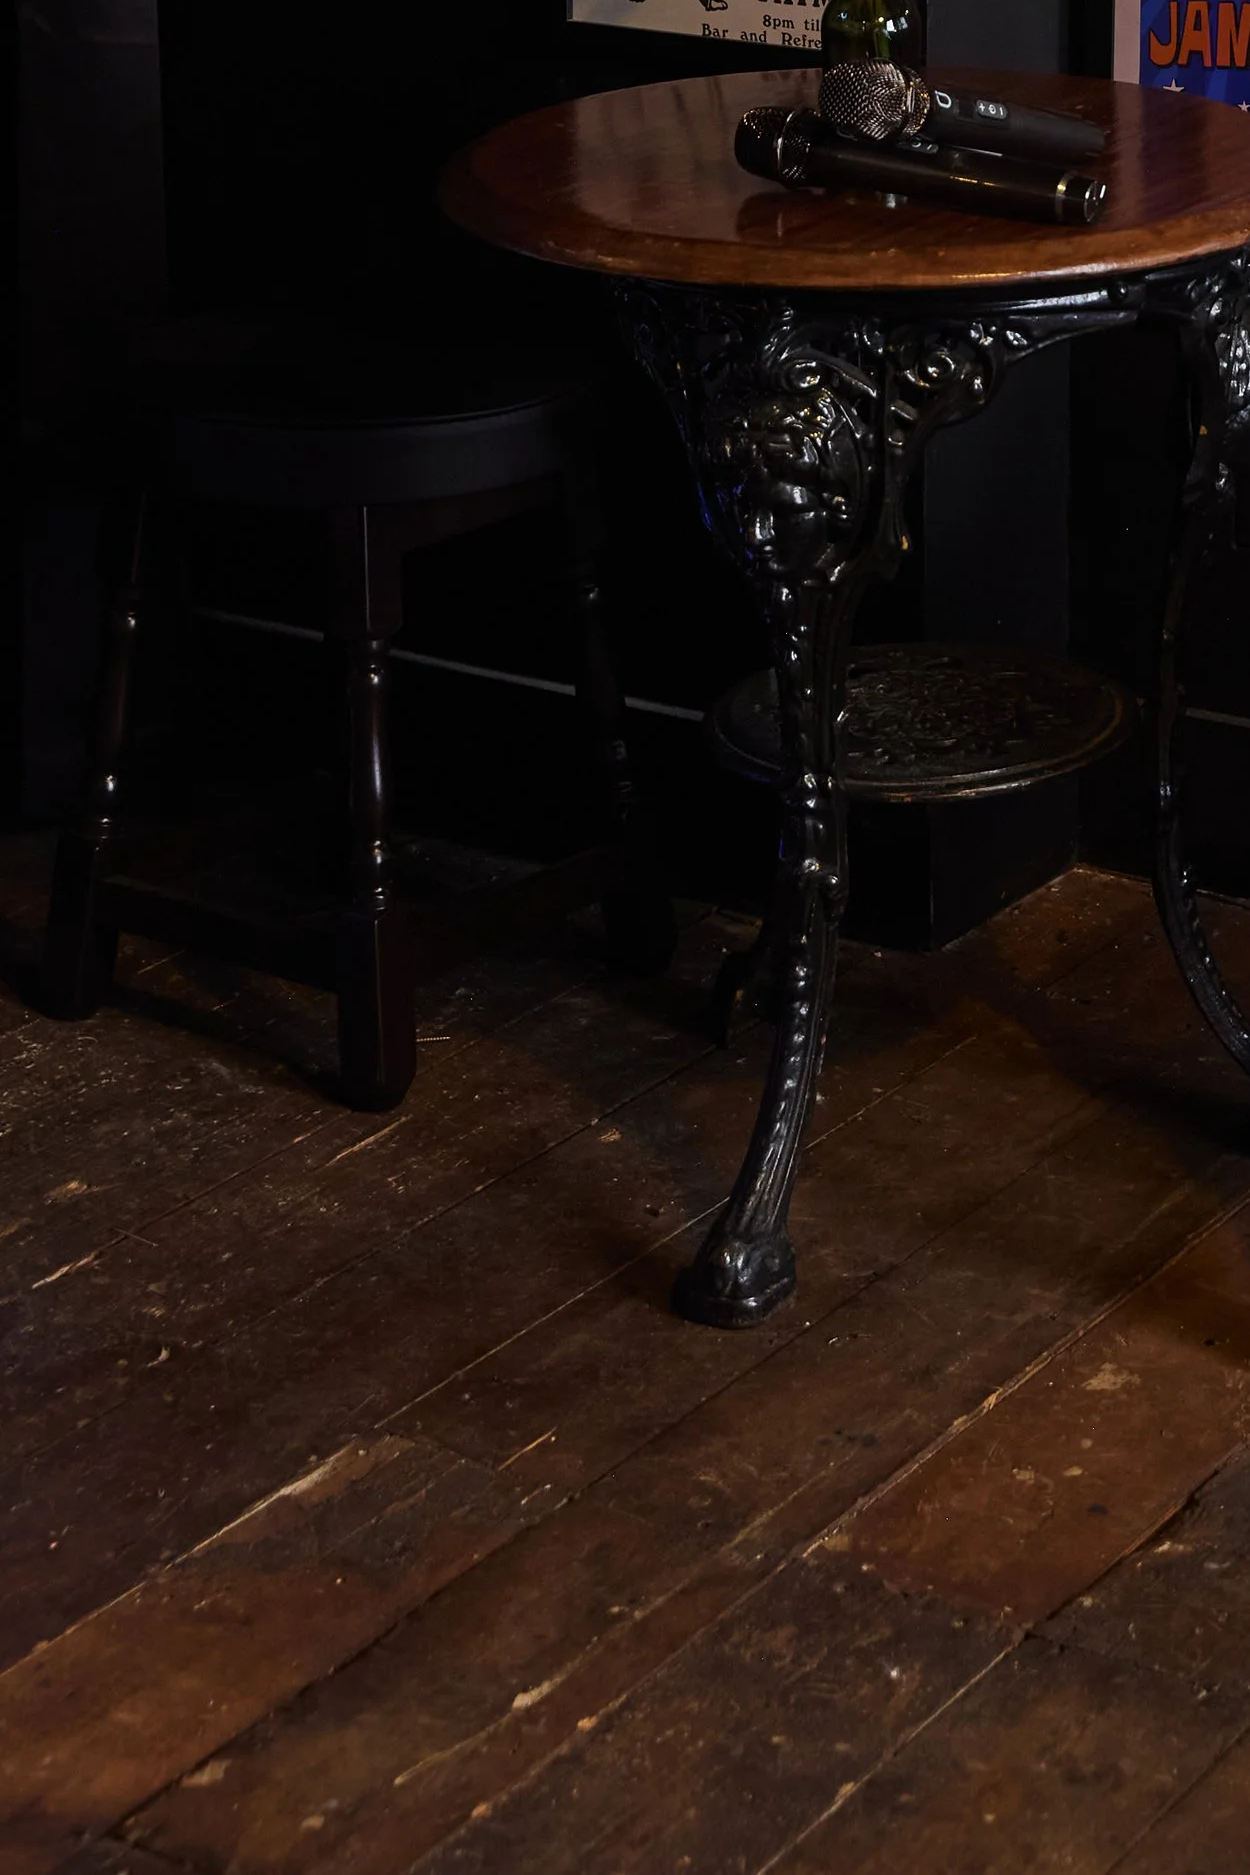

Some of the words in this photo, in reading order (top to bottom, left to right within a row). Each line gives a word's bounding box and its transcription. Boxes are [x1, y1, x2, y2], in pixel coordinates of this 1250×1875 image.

[762, 14, 795, 30] 8pm
[702, 23, 729, 38] Bar
[740, 30, 767, 43] and
